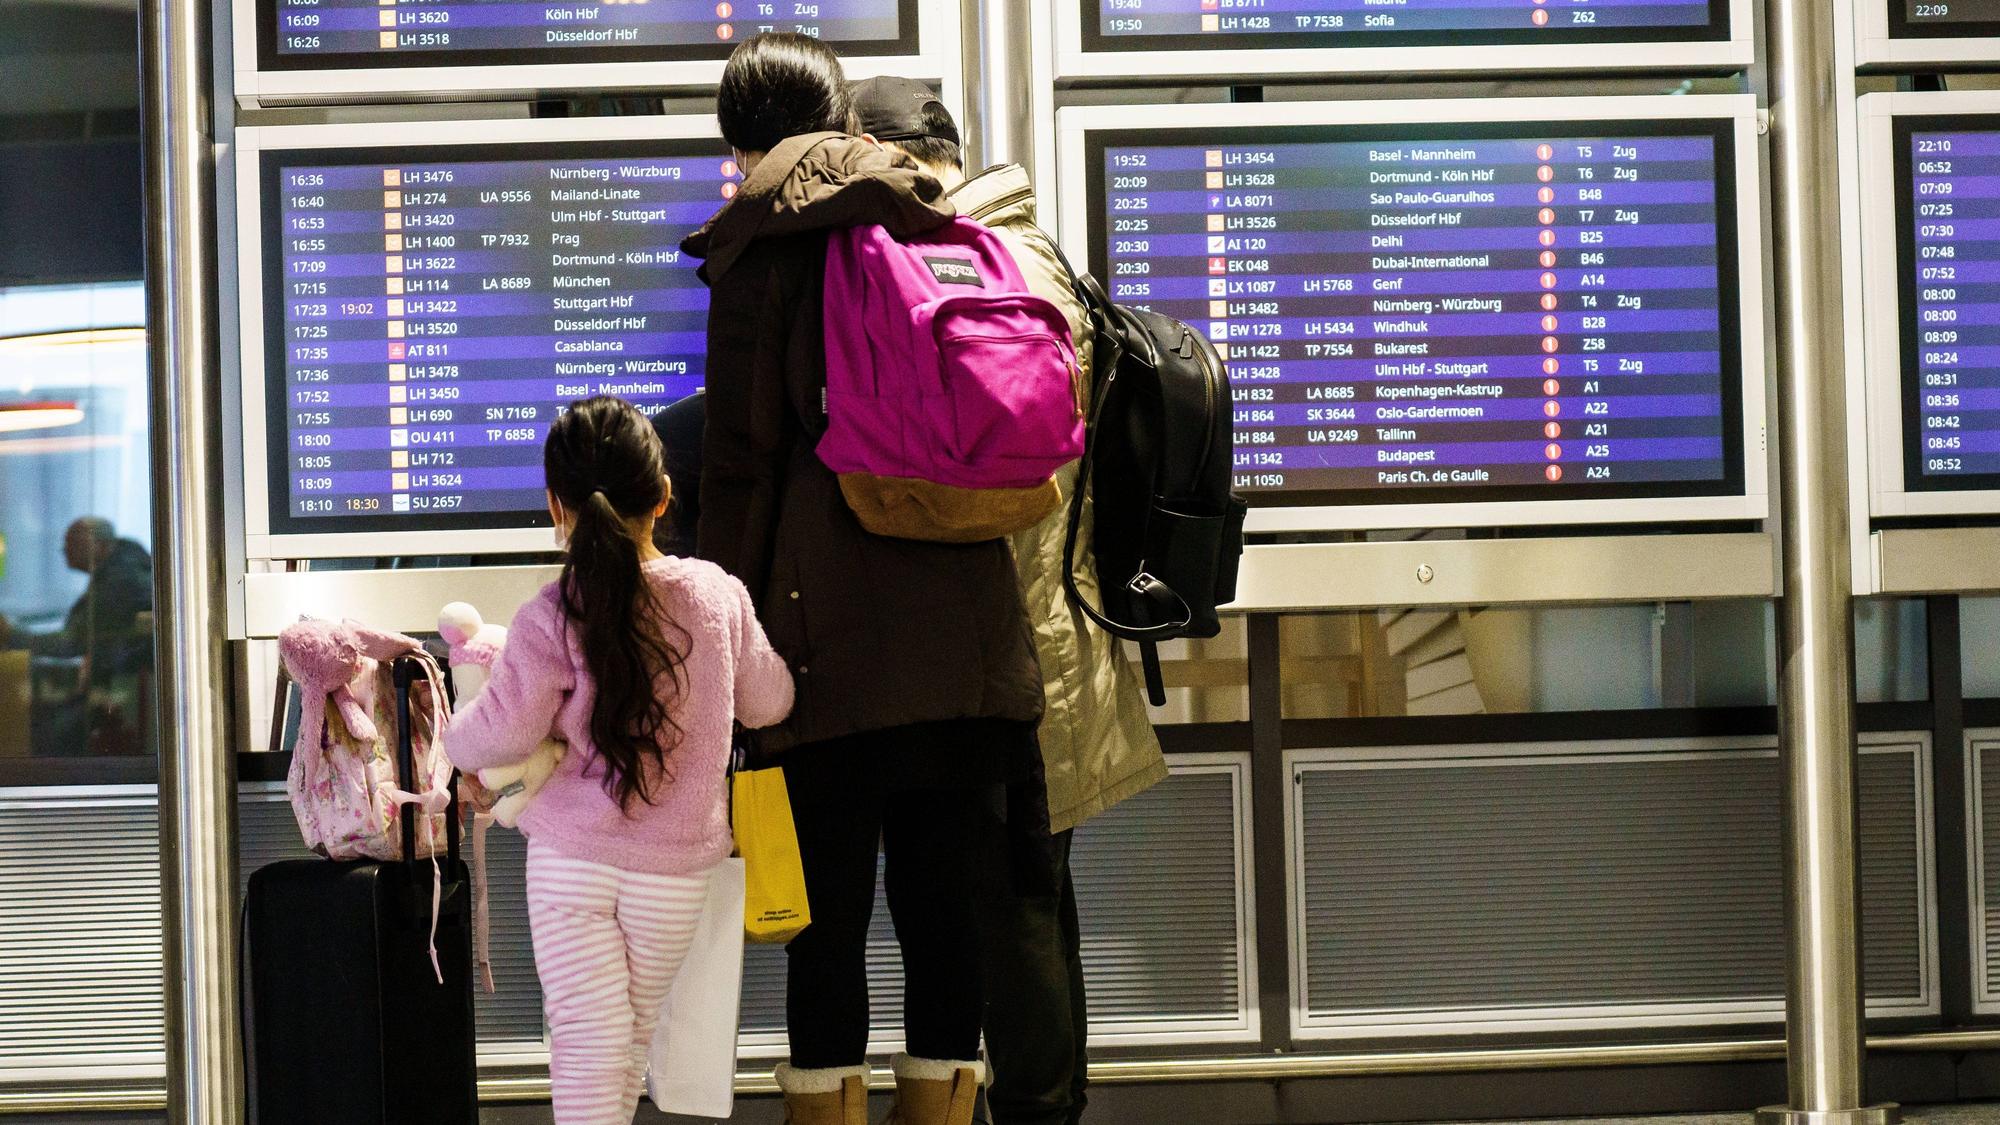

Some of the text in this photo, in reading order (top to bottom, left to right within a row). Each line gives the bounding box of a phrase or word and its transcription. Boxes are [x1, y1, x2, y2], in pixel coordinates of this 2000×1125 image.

[286, 3, 819, 27] 16:09 LH 3620 Köln Hbf T6 Zug
[1108, 0, 1143, 10] 19:40
[1915, 4, 1948, 17] 22:09
[1109, 11, 1596, 31] 19:50 LH 1428 TP 7538 Sofia Z62
[286, 36, 321, 49] 16:26
[399, 33, 417, 46] LH
[419, 33, 450, 46] 3518
[546, 28, 613, 43] Düsseldorf
[615, 28, 638, 40] Hbf
[795, 24, 819, 39] Zug
[1113, 145, 1637, 167] 19:52 LH 3454 Basel Mannheim T5 Zug
[1918, 140, 1952, 153] 22:10
[290, 165, 681, 186] 16:36 LH 3476 Nürnberg Würzburg
[1918, 161, 1952, 174] 06:52
[291, 188, 641, 208] 16:40 LH 274 UA 9556 Mailand-Linate
[1919, 182, 1953, 195] 07:09
[1114, 188, 1603, 210] 20:25 LA 8071 Sao Paulo-Guarulhos B48
[1920, 224, 1954, 237] 07:30
[292, 232, 580, 252] 16:55 LH 1400 TP 7932 Prag
[1115, 231, 1604, 254] 20:30 AI 120 Delhi B25
[1921, 245, 1955, 259] 07:48
[292, 250, 680, 273] 17:09 LH 3622 Dortmund Köln Hbf
[1115, 252, 1605, 275] 20:30 EK 048 Dubai-International B46
[293, 275, 611, 295] 17:15 LH 114 LA 8689 München
[1116, 273, 1606, 296] 20:35 LX 1087 LH 5768 Genf A14
[1922, 288, 1957, 301] 08:00
[294, 295, 634, 317] 17:23 19:02 LH 3422 Stuttgart Hbf
[1229, 316, 1606, 337] EW 1278 LH 5434 Windhuk B28
[1924, 330, 1958, 344] 08:09
[295, 339, 624, 360] 17:35 AT 811 Casablanca
[1924, 351, 1959, 365] 08:24
[1231, 380, 1599, 402] LH 832 LA 8685 Kopenhagen-Kastrup A1
[1926, 394, 1960, 407] 08:36
[297, 412, 331, 425] 17:55
[410, 409, 427, 423] LH
[429, 409, 453, 422] 690
[486, 407, 504, 420] SN
[505, 406, 537, 420] 7169
[297, 428, 536, 447] 18:00 OU 411 TP 6858
[1927, 436, 1961, 450] 08:45
[298, 452, 454, 469] 18:05 LH 712
[1233, 444, 1610, 466] LH 1342 Budapest A25
[1928, 458, 1962, 471] 08:52
[1233, 466, 1611, 488] LH 1050 Paris Ch. de Gaulle A24
[299, 495, 463, 512] 18:10 18:30 SU 2657
